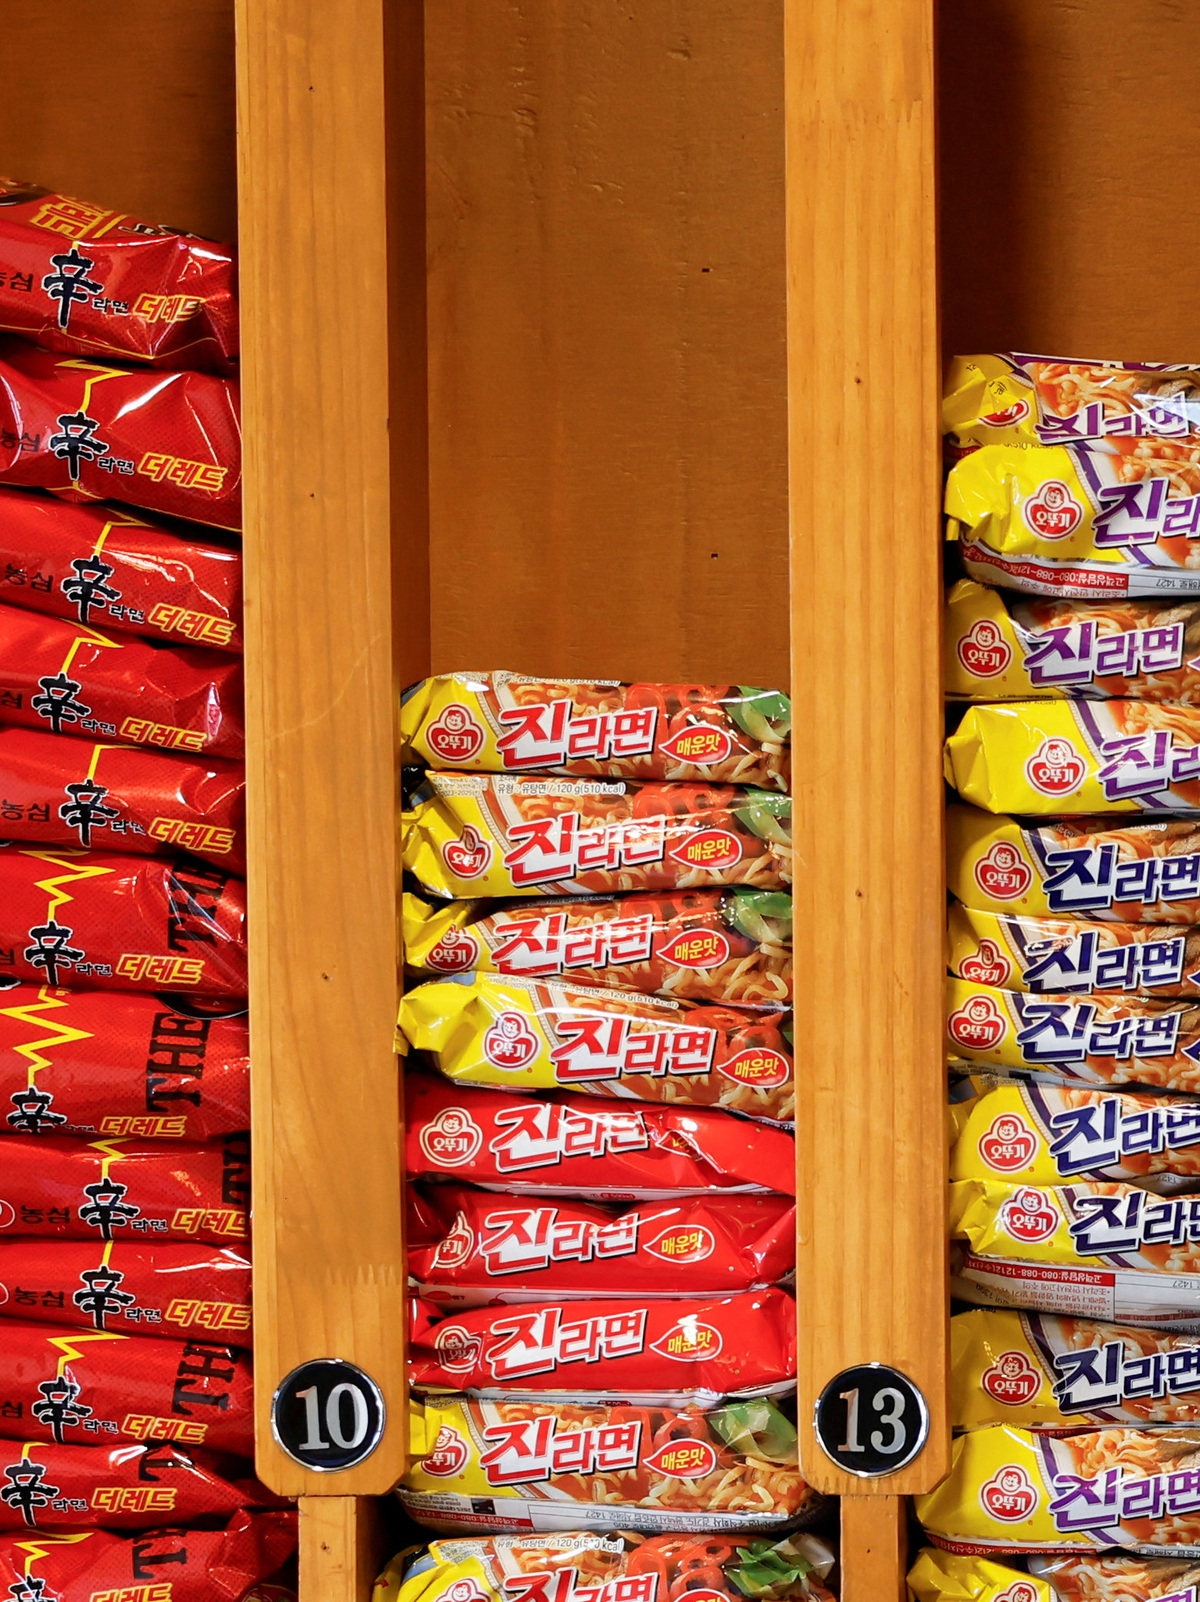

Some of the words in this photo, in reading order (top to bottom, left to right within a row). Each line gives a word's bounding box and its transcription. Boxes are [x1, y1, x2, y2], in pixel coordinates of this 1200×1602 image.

[0, 272, 34, 292] 심
[133, 293, 206, 322] 더레드
[137, 452, 228, 491] 더레드
[1036, 510, 1071, 528] 오뚜기
[1093, 477, 1200, 548] 진라
[4, 563, 53, 592] 농심
[148, 602, 237, 646] 더레드
[1156, 579, 1176, 589] 1427
[968, 649, 1000, 667] 오뚜기
[1023, 620, 1184, 687] 진라면
[0, 692, 23, 710] 심
[119, 716, 208, 752] 더레드
[437, 733, 472, 751] 오뚜기
[496, 699, 658, 770] 진라면
[676, 734, 721, 756] 매운맛
[522, 783, 548, 794] 유탕면
[557, 784, 573, 794] 120
[602, 782, 626, 795] kcal)
[1039, 769, 1074, 784] 오뚜기
[0, 800, 50, 822] 농심
[148, 817, 237, 854] 더레드
[504, 812, 667, 888] 진라면
[687, 838, 731, 862] 매운맛
[986, 872, 1021, 889] 오뚜기
[1043, 843, 1200, 912] 진라면
[115, 953, 205, 985] 더레드
[432, 947, 468, 965] 오뚜기
[491, 912, 656, 977] 진라면
[674, 937, 720, 961] 매운맛
[967, 966, 1000, 982] 오뚜기
[1023, 931, 1185, 994] 진라면
[610, 990, 626, 1000] 120
[146, 1012, 213, 1112] THE
[492, 1041, 527, 1059] 오뚜기
[550, 1017, 718, 1084] 진라면
[735, 1056, 780, 1078] 매운맛
[959, 1024, 994, 1041] 오뚜기
[1017, 1004, 1182, 1063] 진라면
[100, 1115, 188, 1138] 더레드
[433, 1135, 469, 1152] 오뚜기
[489, 1102, 650, 1173] 진라면
[990, 1144, 1025, 1159] 오뚜기
[21, 1205, 71, 1224] 농심
[480, 1207, 640, 1276] 진라면
[661, 1232, 704, 1254] 매운맛
[1012, 1214, 1047, 1232] 오뚜기
[1069, 1190, 1200, 1254] 진라
[14, 1287, 65, 1308] 농심
[164, 1299, 252, 1330] 더레드
[1173, 1279, 1194, 1288] 1427
[485, 1307, 648, 1381] 진라면
[171, 1340, 240, 1416] TH
[994, 1380, 1029, 1396] 오뚜기
[1051, 1340, 1200, 1415] 진라면
[0, 1401, 23, 1419] 심
[121, 1413, 209, 1444] 더레드
[295, 1382, 369, 1450] 10
[837, 1387, 907, 1454] 13
[480, 1416, 642, 1486] 진라면
[661, 1448, 706, 1471] 매운맛
[91, 1486, 178, 1512] 더레드
[586, 1510, 606, 1518] 1427
[992, 1496, 1027, 1512] 오뚜기
[1048, 1466, 1200, 1533] 진라면
[556, 1539, 572, 1548] 120
